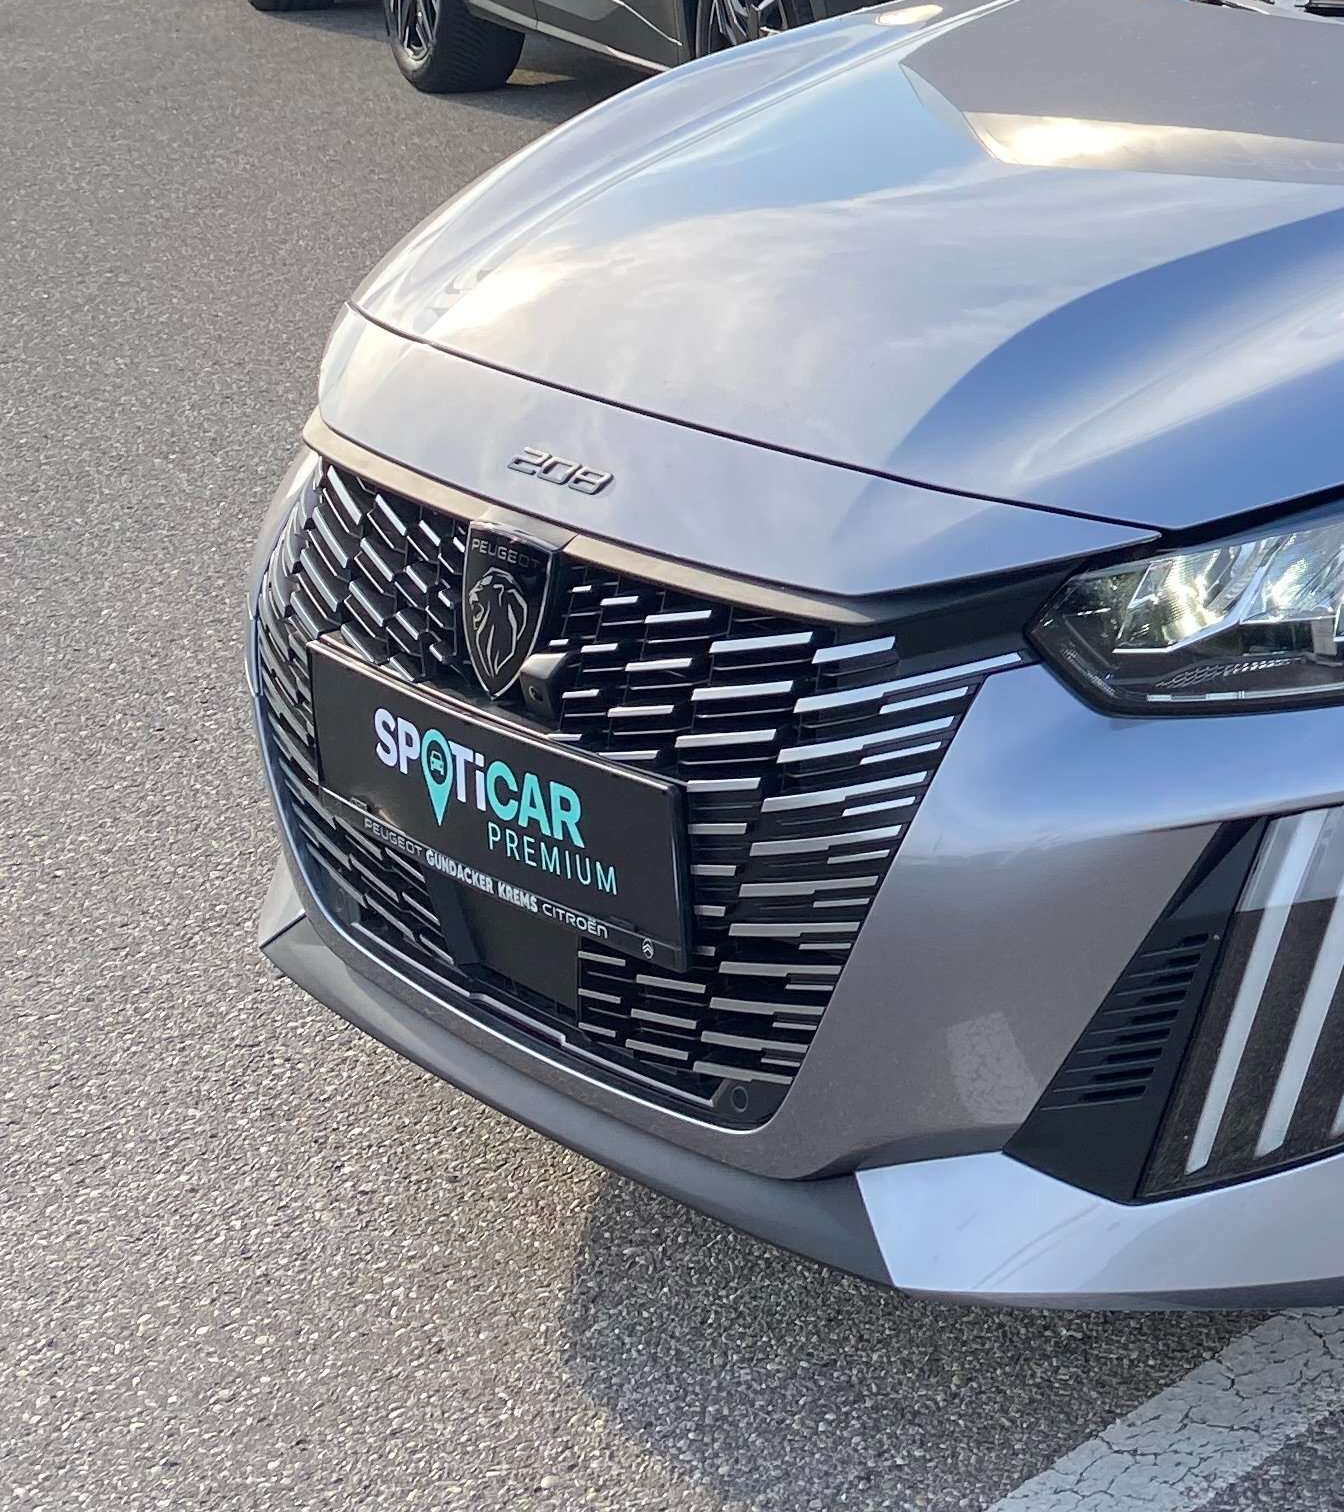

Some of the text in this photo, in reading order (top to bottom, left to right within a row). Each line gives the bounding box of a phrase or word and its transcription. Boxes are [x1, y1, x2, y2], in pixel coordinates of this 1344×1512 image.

[507, 445, 616, 496] 208
[471, 538, 541, 569] PEUGEOT
[364, 817, 423, 856] PEUGEOT
[426, 849, 494, 895] GUNDACKER
[498, 881, 538, 913] KREMS
[488, 821, 617, 896] PREMIUM
